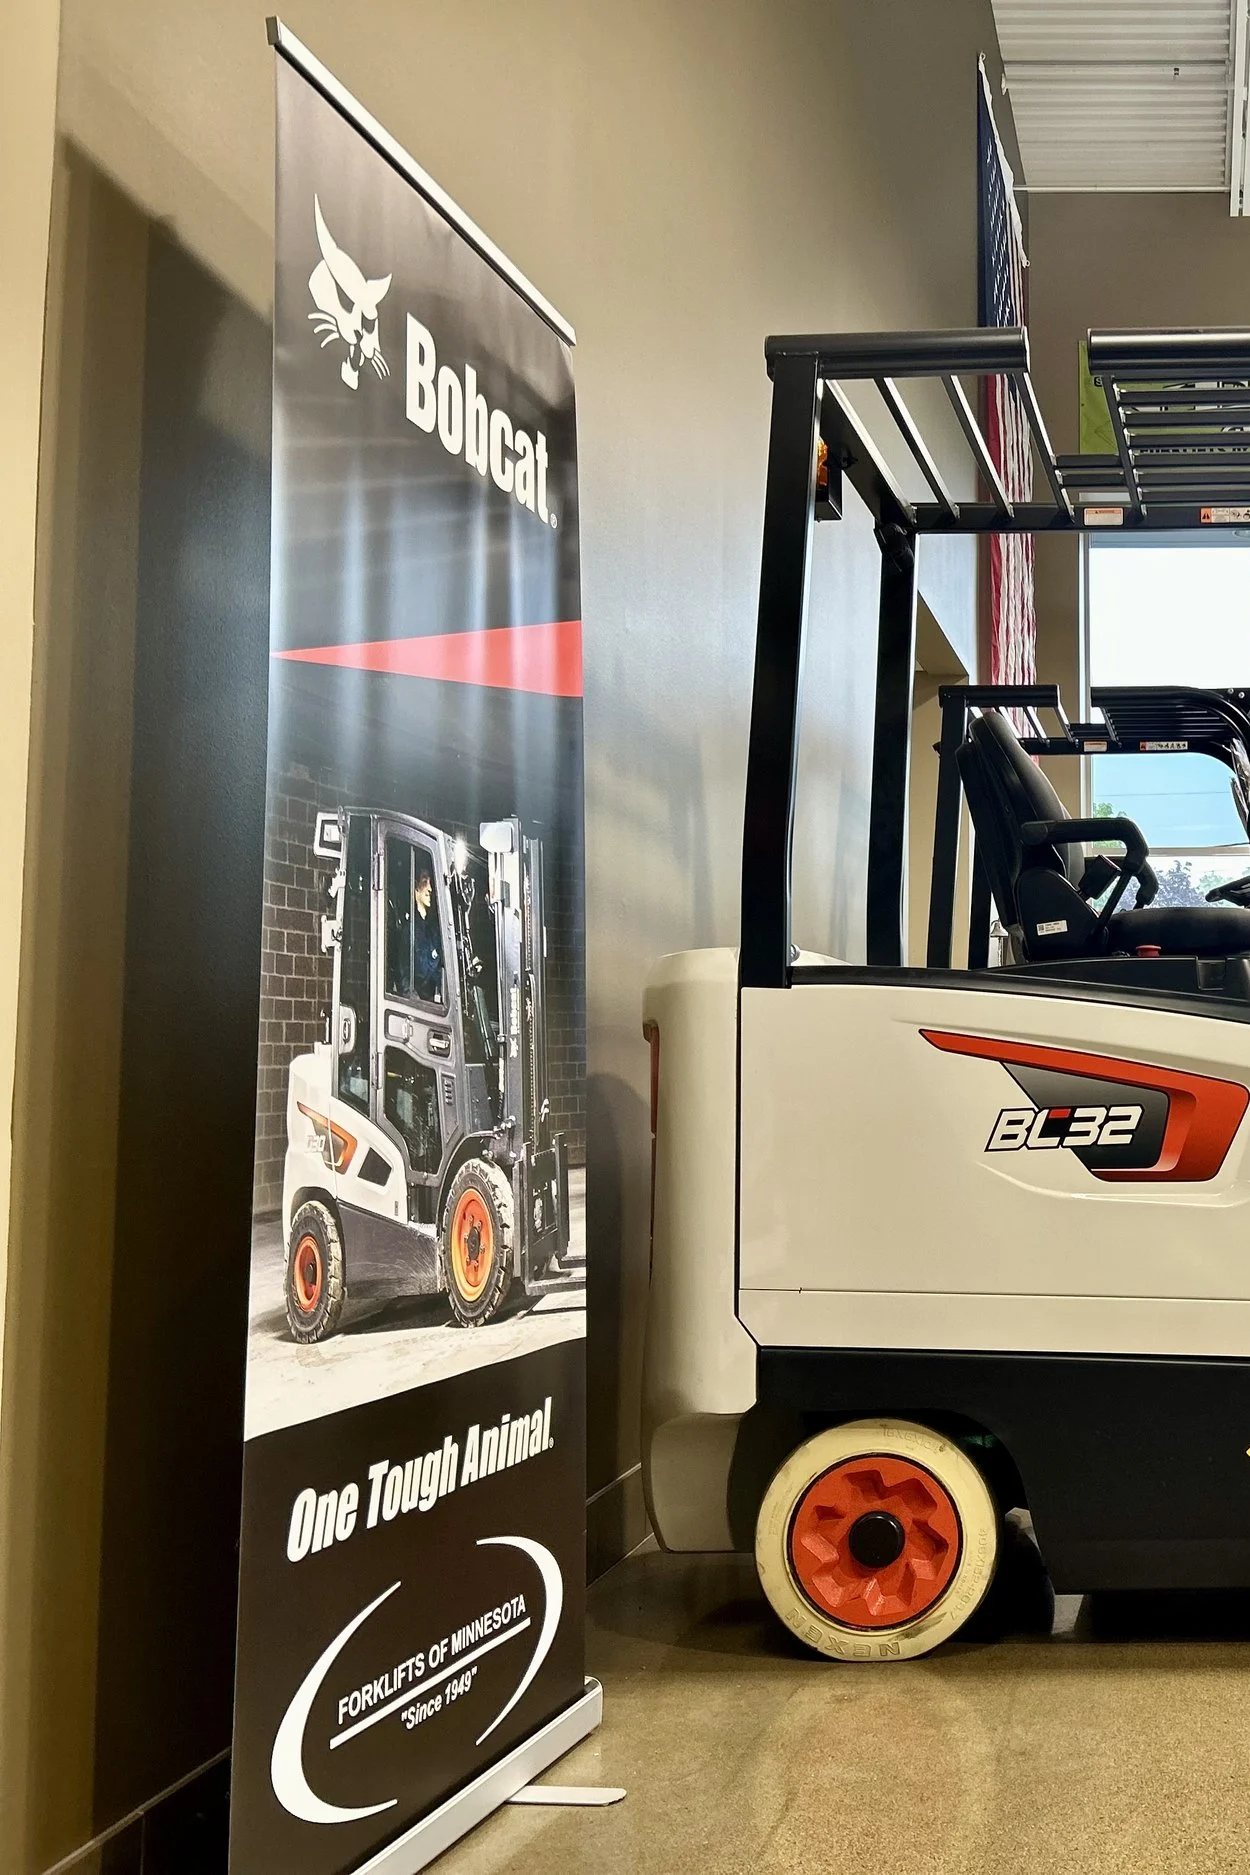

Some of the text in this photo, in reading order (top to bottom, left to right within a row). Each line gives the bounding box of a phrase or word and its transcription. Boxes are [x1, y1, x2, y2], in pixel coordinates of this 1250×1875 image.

[985, 1105, 1144, 1152] BC32
[286, 1481, 359, 1563] One
[366, 1435, 459, 1529] Tough
[338, 1594, 526, 1725] FORKLIFTS OF MINNESOTA
[785, 1607, 902, 1658] NEXEN
